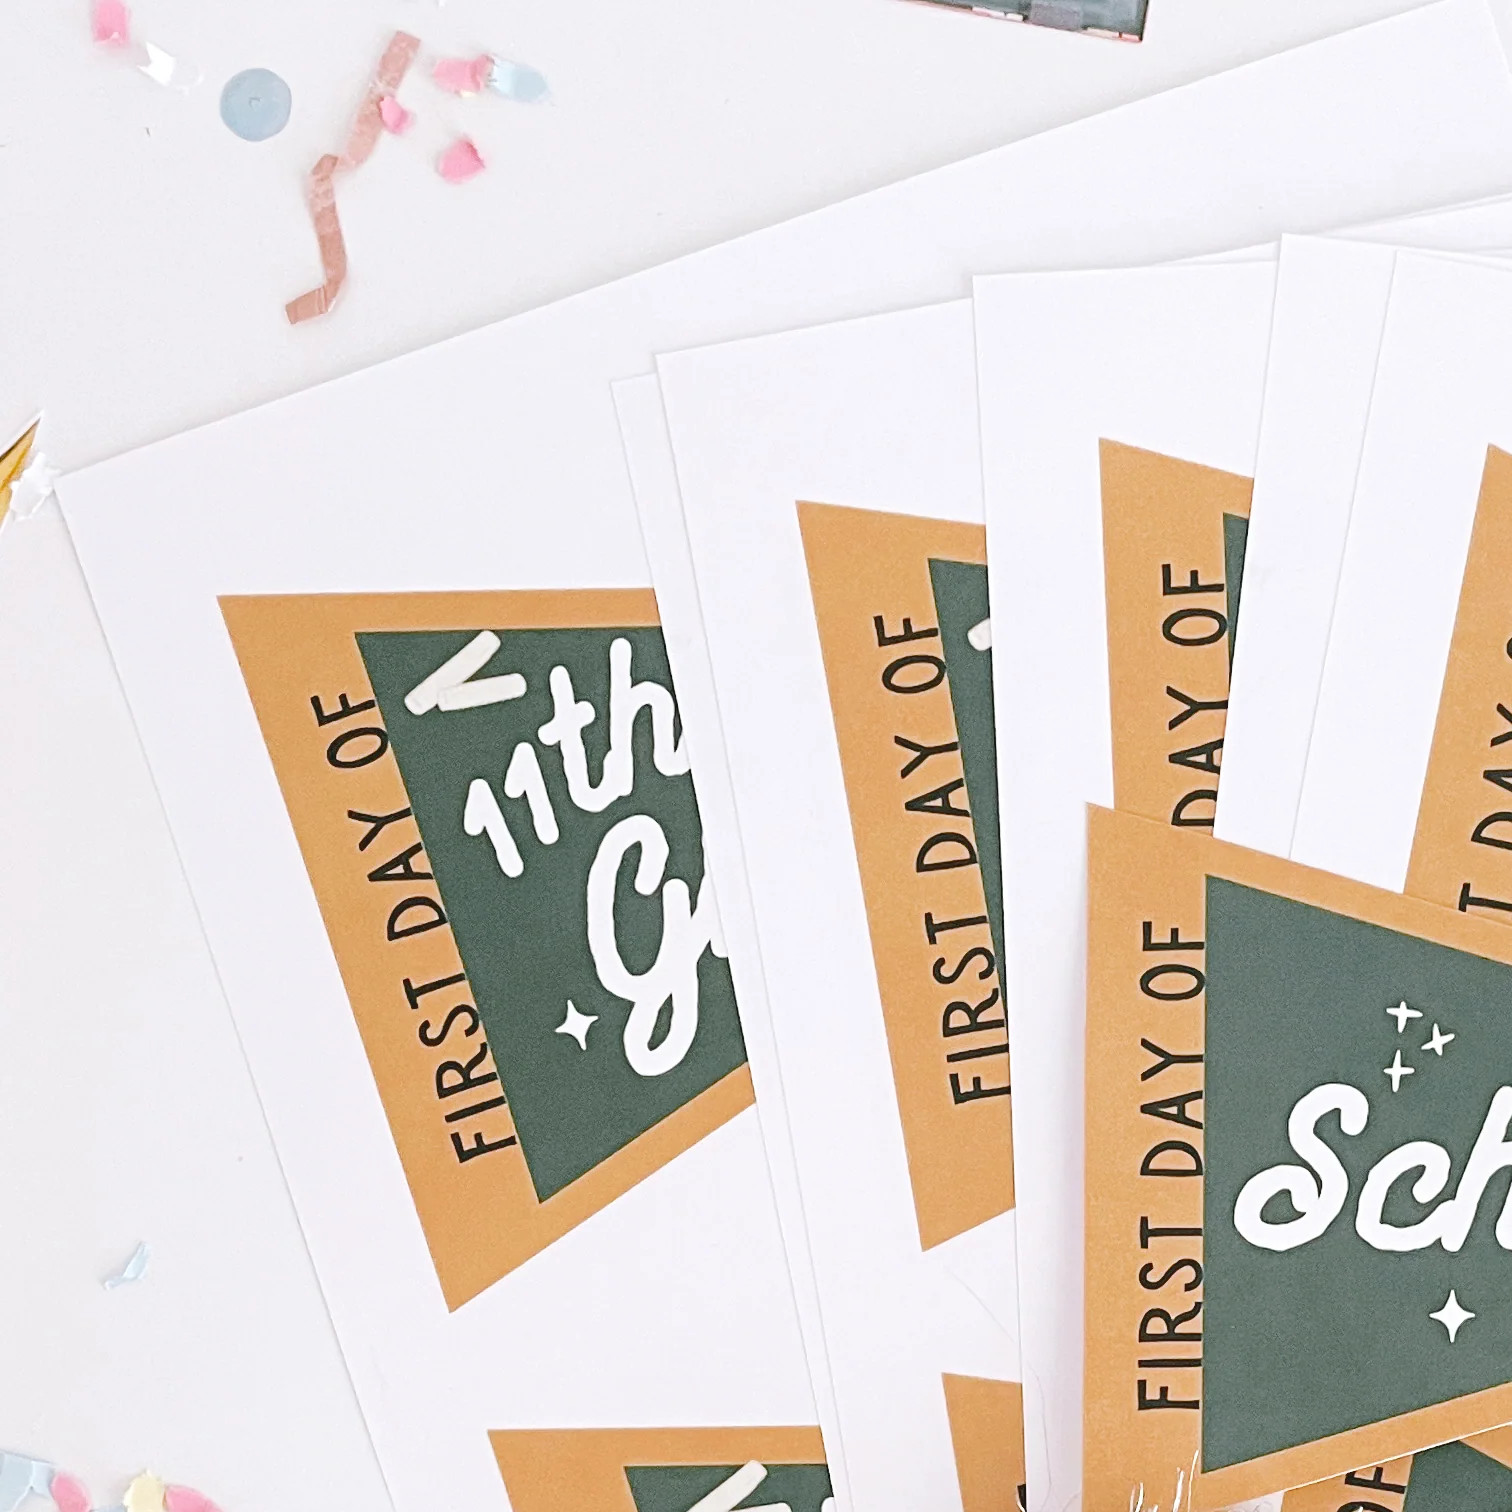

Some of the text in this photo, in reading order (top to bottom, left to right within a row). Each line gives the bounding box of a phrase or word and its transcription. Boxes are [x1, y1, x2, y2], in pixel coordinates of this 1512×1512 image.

[1161, 563, 1230, 646] OF
[311, 691, 518, 1165] FIRST DAY OF
[874, 615, 1011, 1106] FIRST DAY OF
[1137, 919, 1205, 1412] FIRST DAY OF
